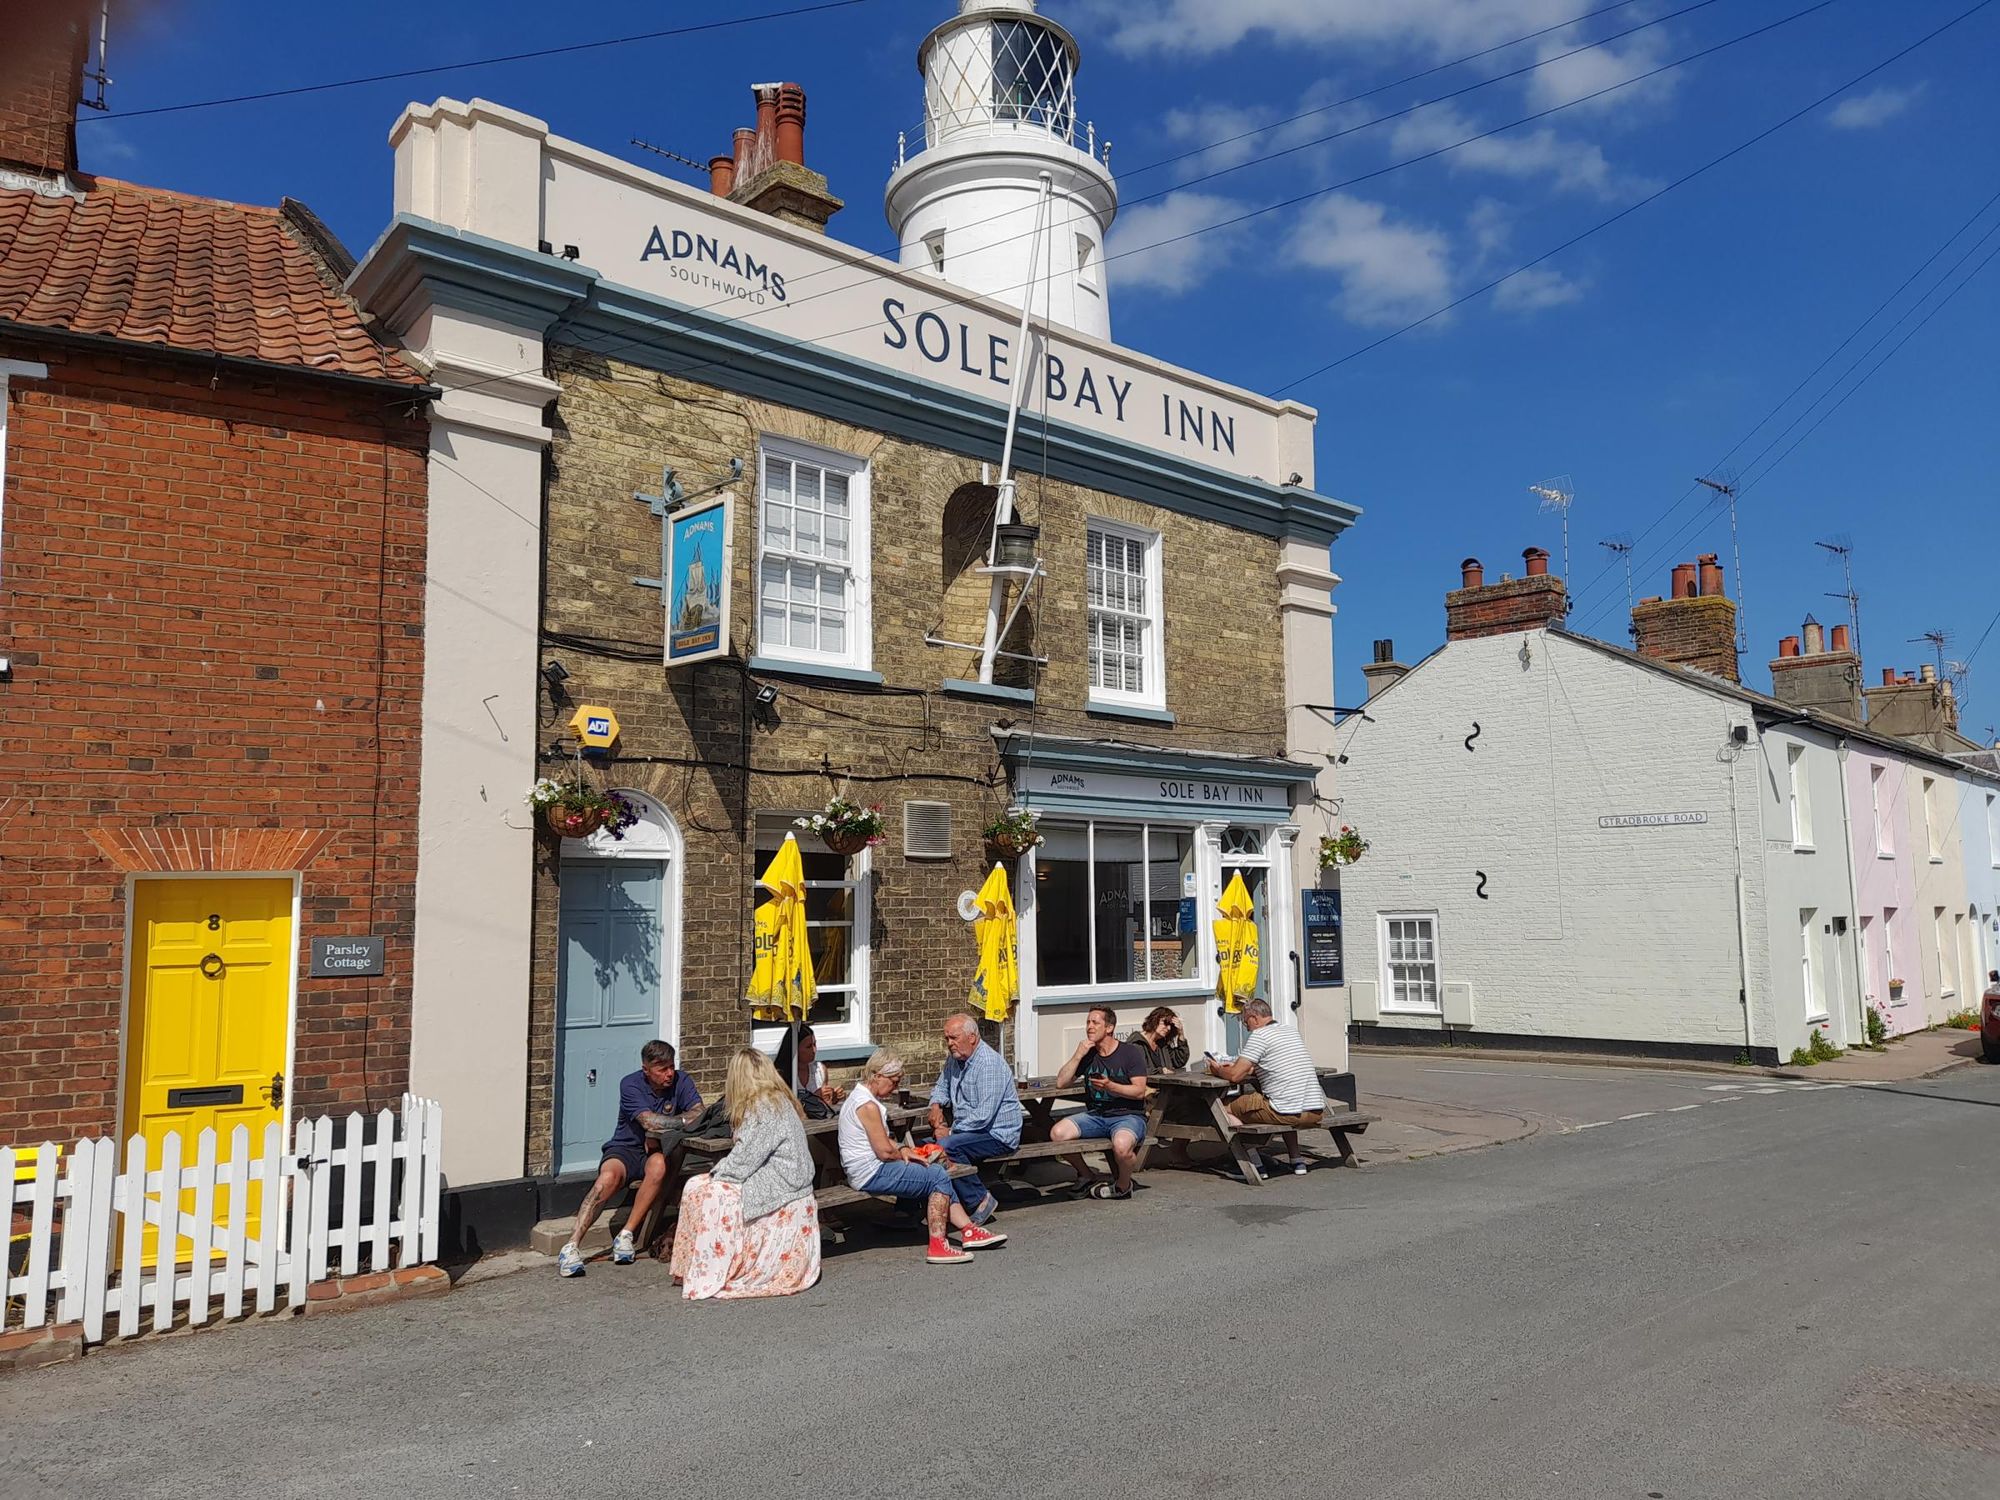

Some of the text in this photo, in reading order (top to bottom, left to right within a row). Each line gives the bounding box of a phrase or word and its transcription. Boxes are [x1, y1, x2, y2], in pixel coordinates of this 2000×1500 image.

[640, 224, 787, 302] ADNAMS
[670, 265, 766, 305] SOUTHWOLD
[882, 298, 1236, 458] SOLE BAY INN
[683, 520, 715, 543] ADNAMS
[587, 720, 610, 734] ADT
[1050, 773, 1085, 789] ADNAMS
[1160, 781, 1264, 803] SOLE BAY INN
[1603, 813, 1703, 827] STRADBROKE ROAD
[326, 944, 370, 956] Parsley
[323, 956, 371, 970] Cottage
